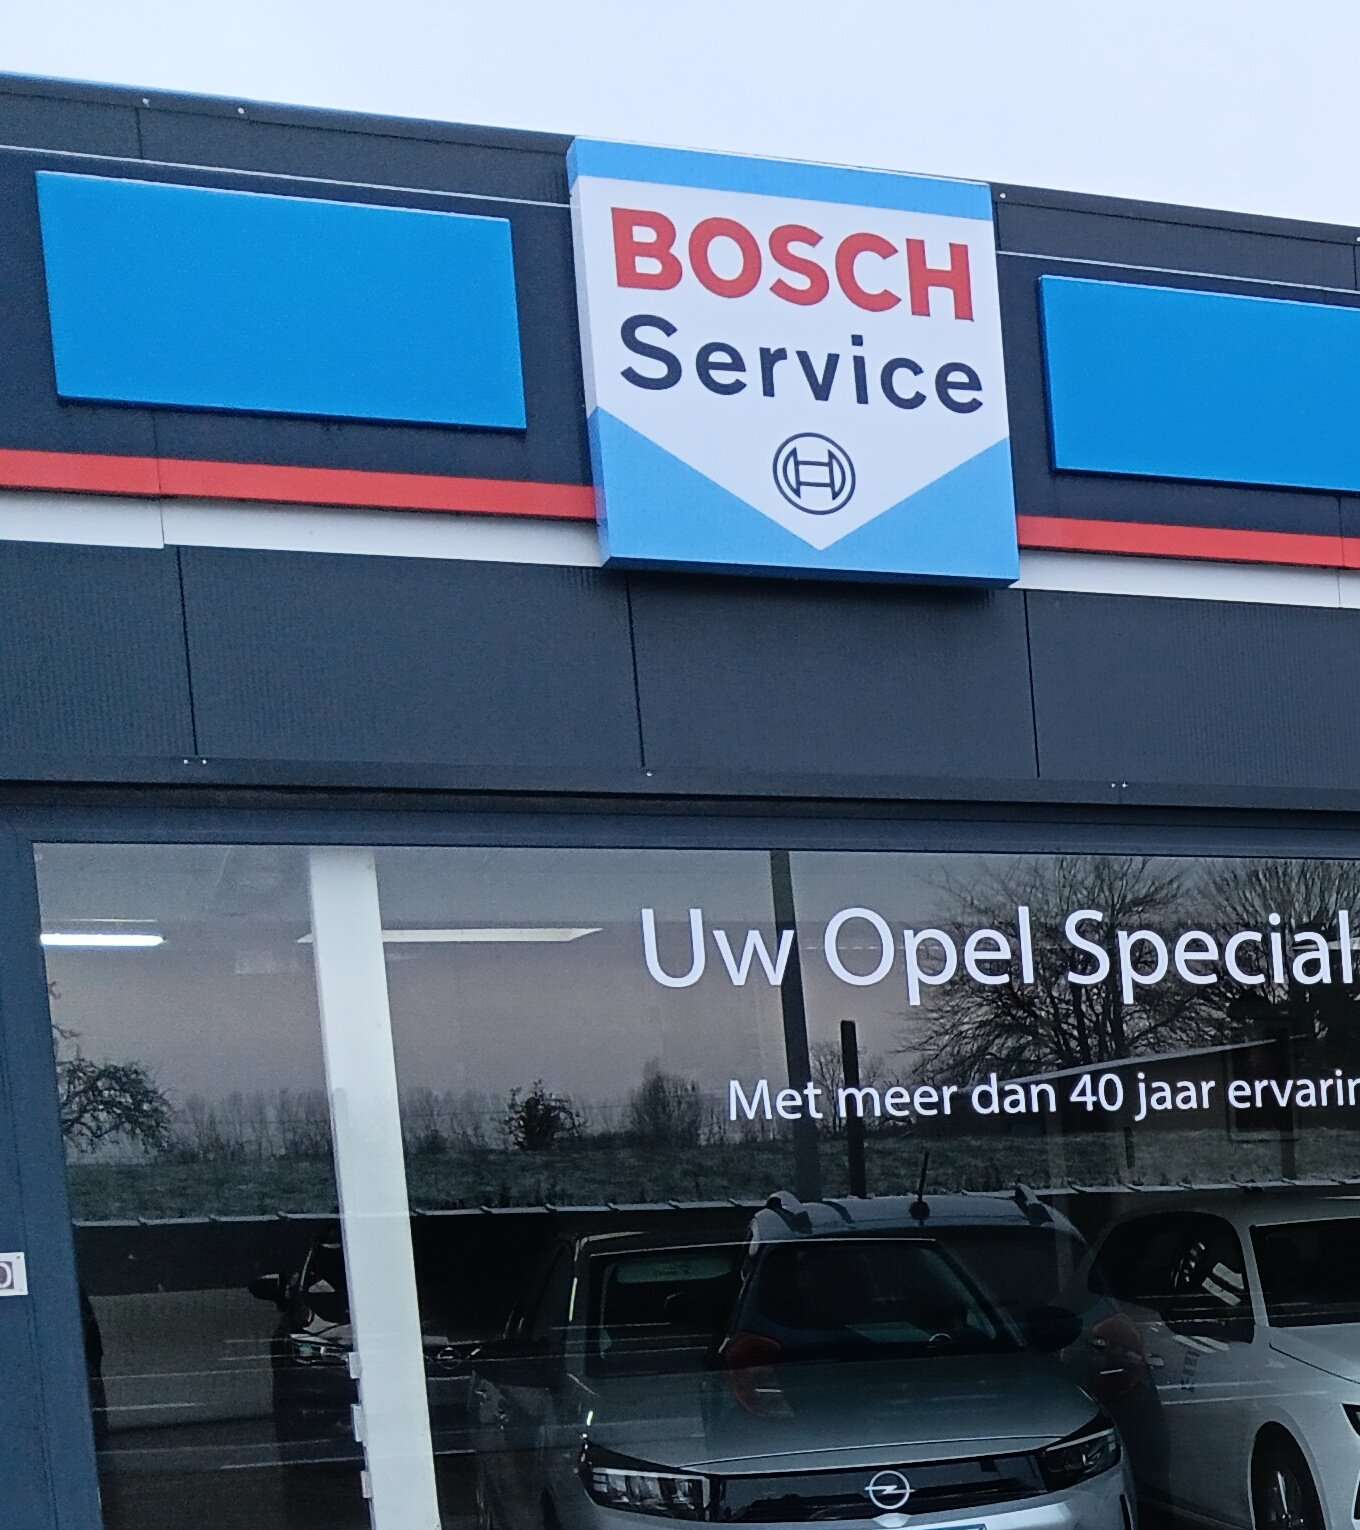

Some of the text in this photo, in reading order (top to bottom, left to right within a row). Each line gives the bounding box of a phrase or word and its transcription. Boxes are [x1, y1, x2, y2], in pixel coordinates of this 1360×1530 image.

[611, 207, 974, 321] BOSCH
[620, 314, 983, 413] Service
[641, 908, 794, 988] Uw
[823, 906, 1034, 1006] Opel
[729, 1079, 823, 1122] Met
[838, 1084, 959, 1120] meer
[971, 1074, 1058, 1116] dan
[1069, 1073, 1124, 1113] 40
[1134, 1071, 1217, 1122] jaar
